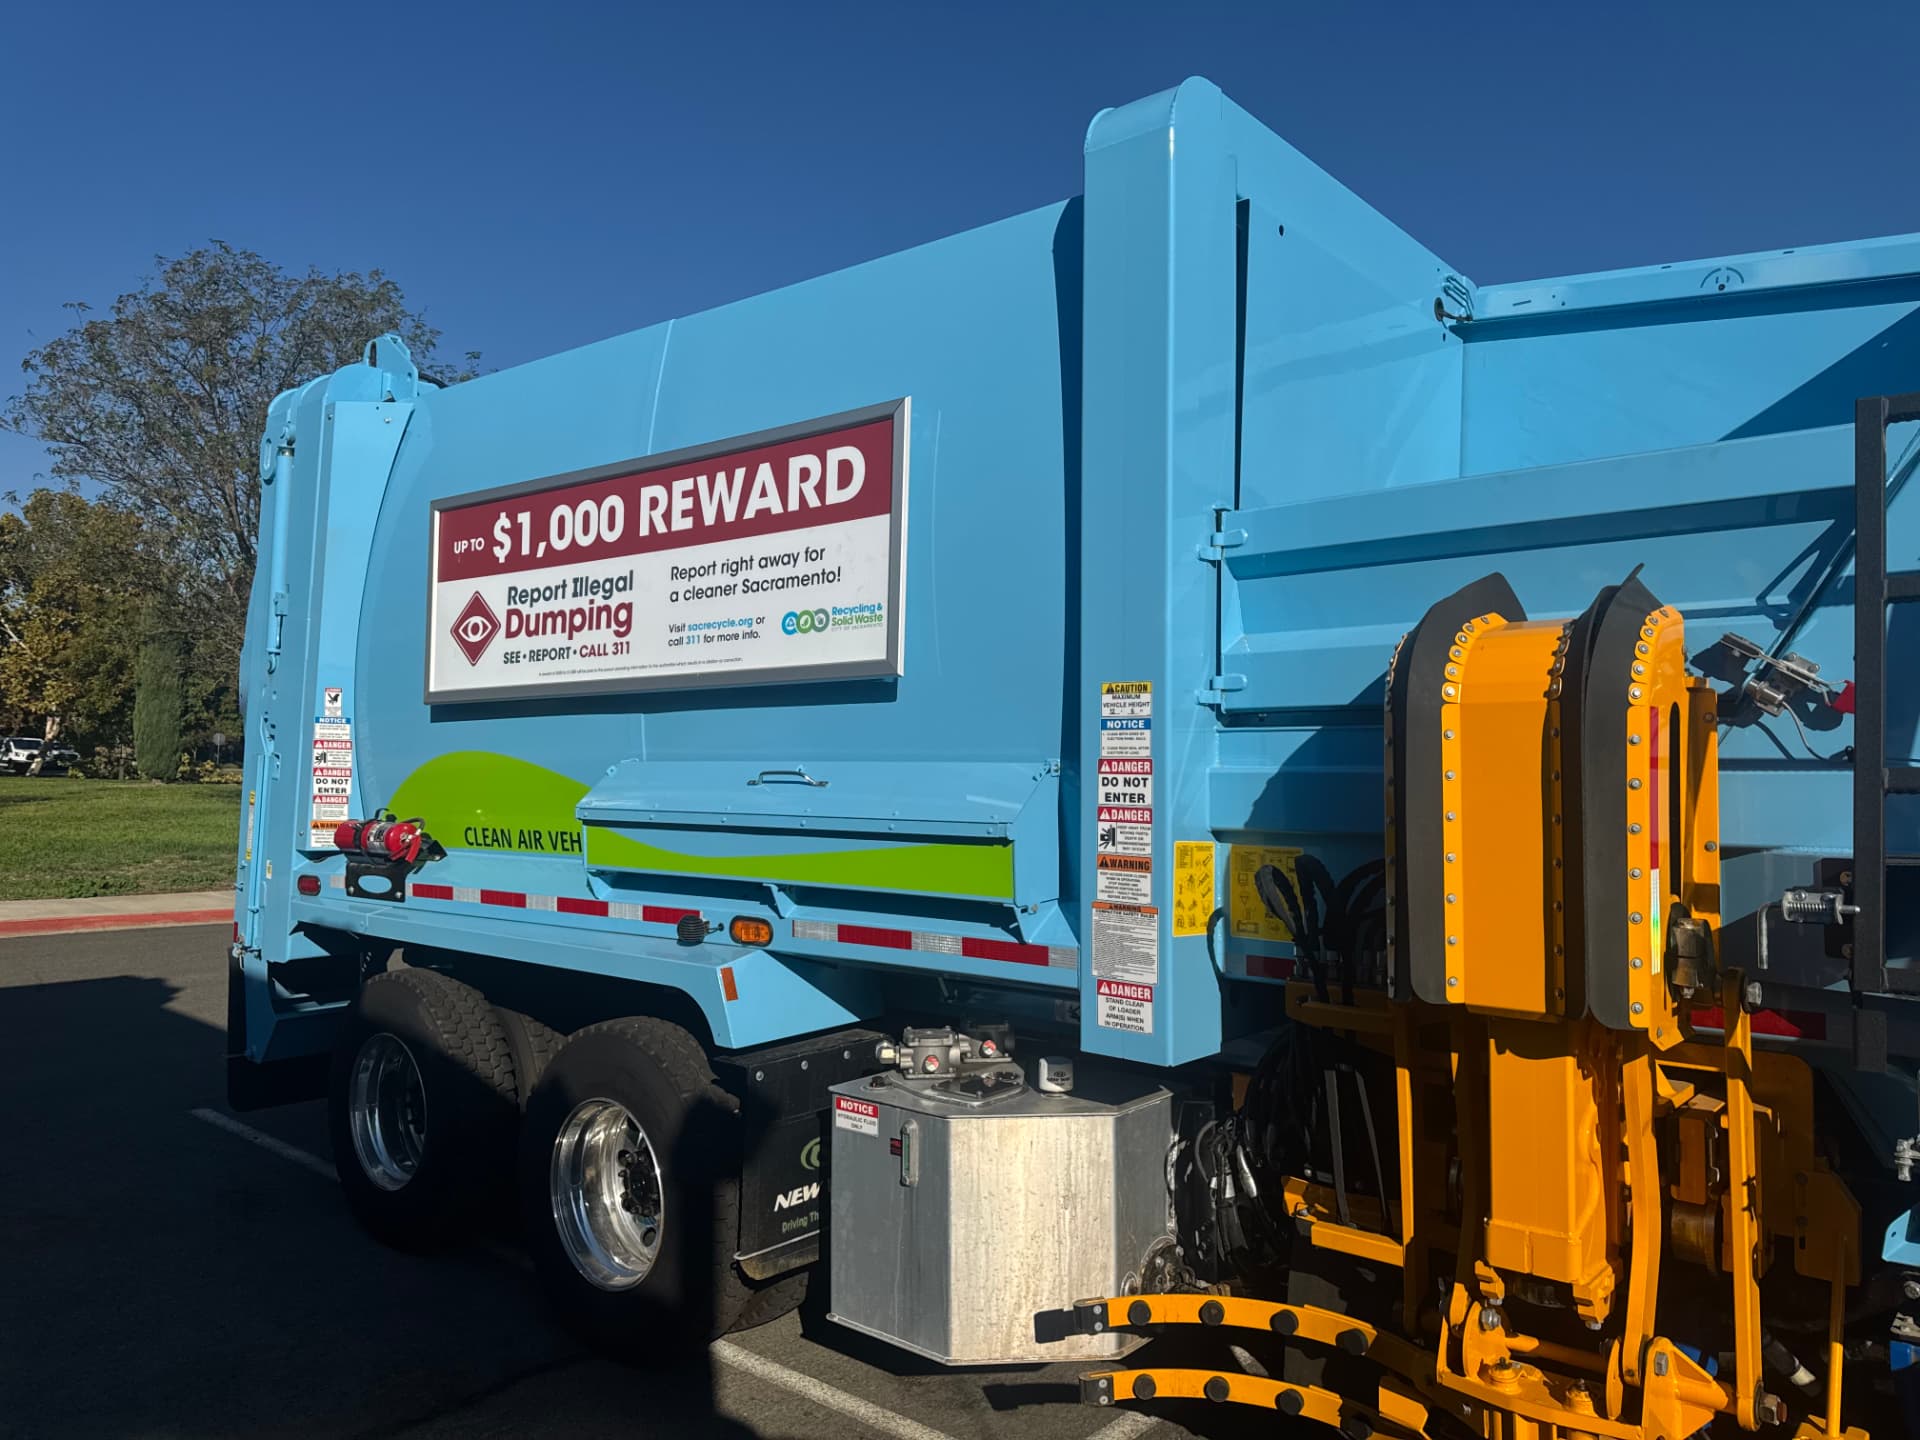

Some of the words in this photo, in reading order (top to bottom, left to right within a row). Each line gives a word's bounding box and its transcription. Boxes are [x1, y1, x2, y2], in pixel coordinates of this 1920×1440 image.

[454, 540, 468, 554] UP
[470, 537, 485, 552] TO
[493, 494, 625, 563] $1,000
[639, 445, 866, 537] REWARD
[671, 560, 717, 582] Report
[721, 554, 754, 577] right
[758, 551, 800, 569] away
[804, 546, 826, 563] for
[507, 578, 568, 608] Report
[572, 569, 634, 601] Illegal
[669, 590, 680, 603] a
[683, 582, 738, 601] cleaner
[741, 566, 841, 594] Sacramento!
[831, 603, 876, 616] Recycling
[876, 602, 883, 611] &
[505, 598, 633, 641] Dumping
[668, 623, 686, 633] Visit
[687, 617, 753, 632] sacrecycle.org
[755, 616, 766, 625] or
[831, 615, 853, 627] Solid
[854, 613, 883, 625] Waste
[667, 636, 684, 647] call
[685, 634, 701, 645] 311
[703, 633, 715, 644] for
[717, 632, 740, 642] more
[742, 629, 761, 640] info.
[503, 651, 521, 665] SEE
[528, 646, 572, 662] REPORT
[579, 643, 609, 658] CALL
[612, 641, 630, 655] 311
[1115, 684, 1148, 693] CAUTION
[1106, 720, 1145, 729] NOTICE
[1111, 761, 1151, 773] DANGER
[1102, 777, 1118, 787] DO
[1123, 777, 1148, 788] NOT
[1105, 792, 1145, 803] ENTER
[1111, 809, 1151, 821] DANGER
[464, 826, 513, 849] CLEAN
[518, 829, 545, 851] AIR
[1109, 858, 1150, 871] WARNING
[1111, 984, 1151, 1000] DANGER
[1105, 997, 1124, 1005] STAND
[1125, 1000, 1144, 1008] CLEAR
[1118, 1007, 1141, 1016] LOADER
[1112, 1022, 1144, 1032] OPERATION
[1126, 1016, 1144, 1024] WHEN
[840, 1099, 874, 1116] NOTICE
[782, 1216, 809, 1233] Driving
